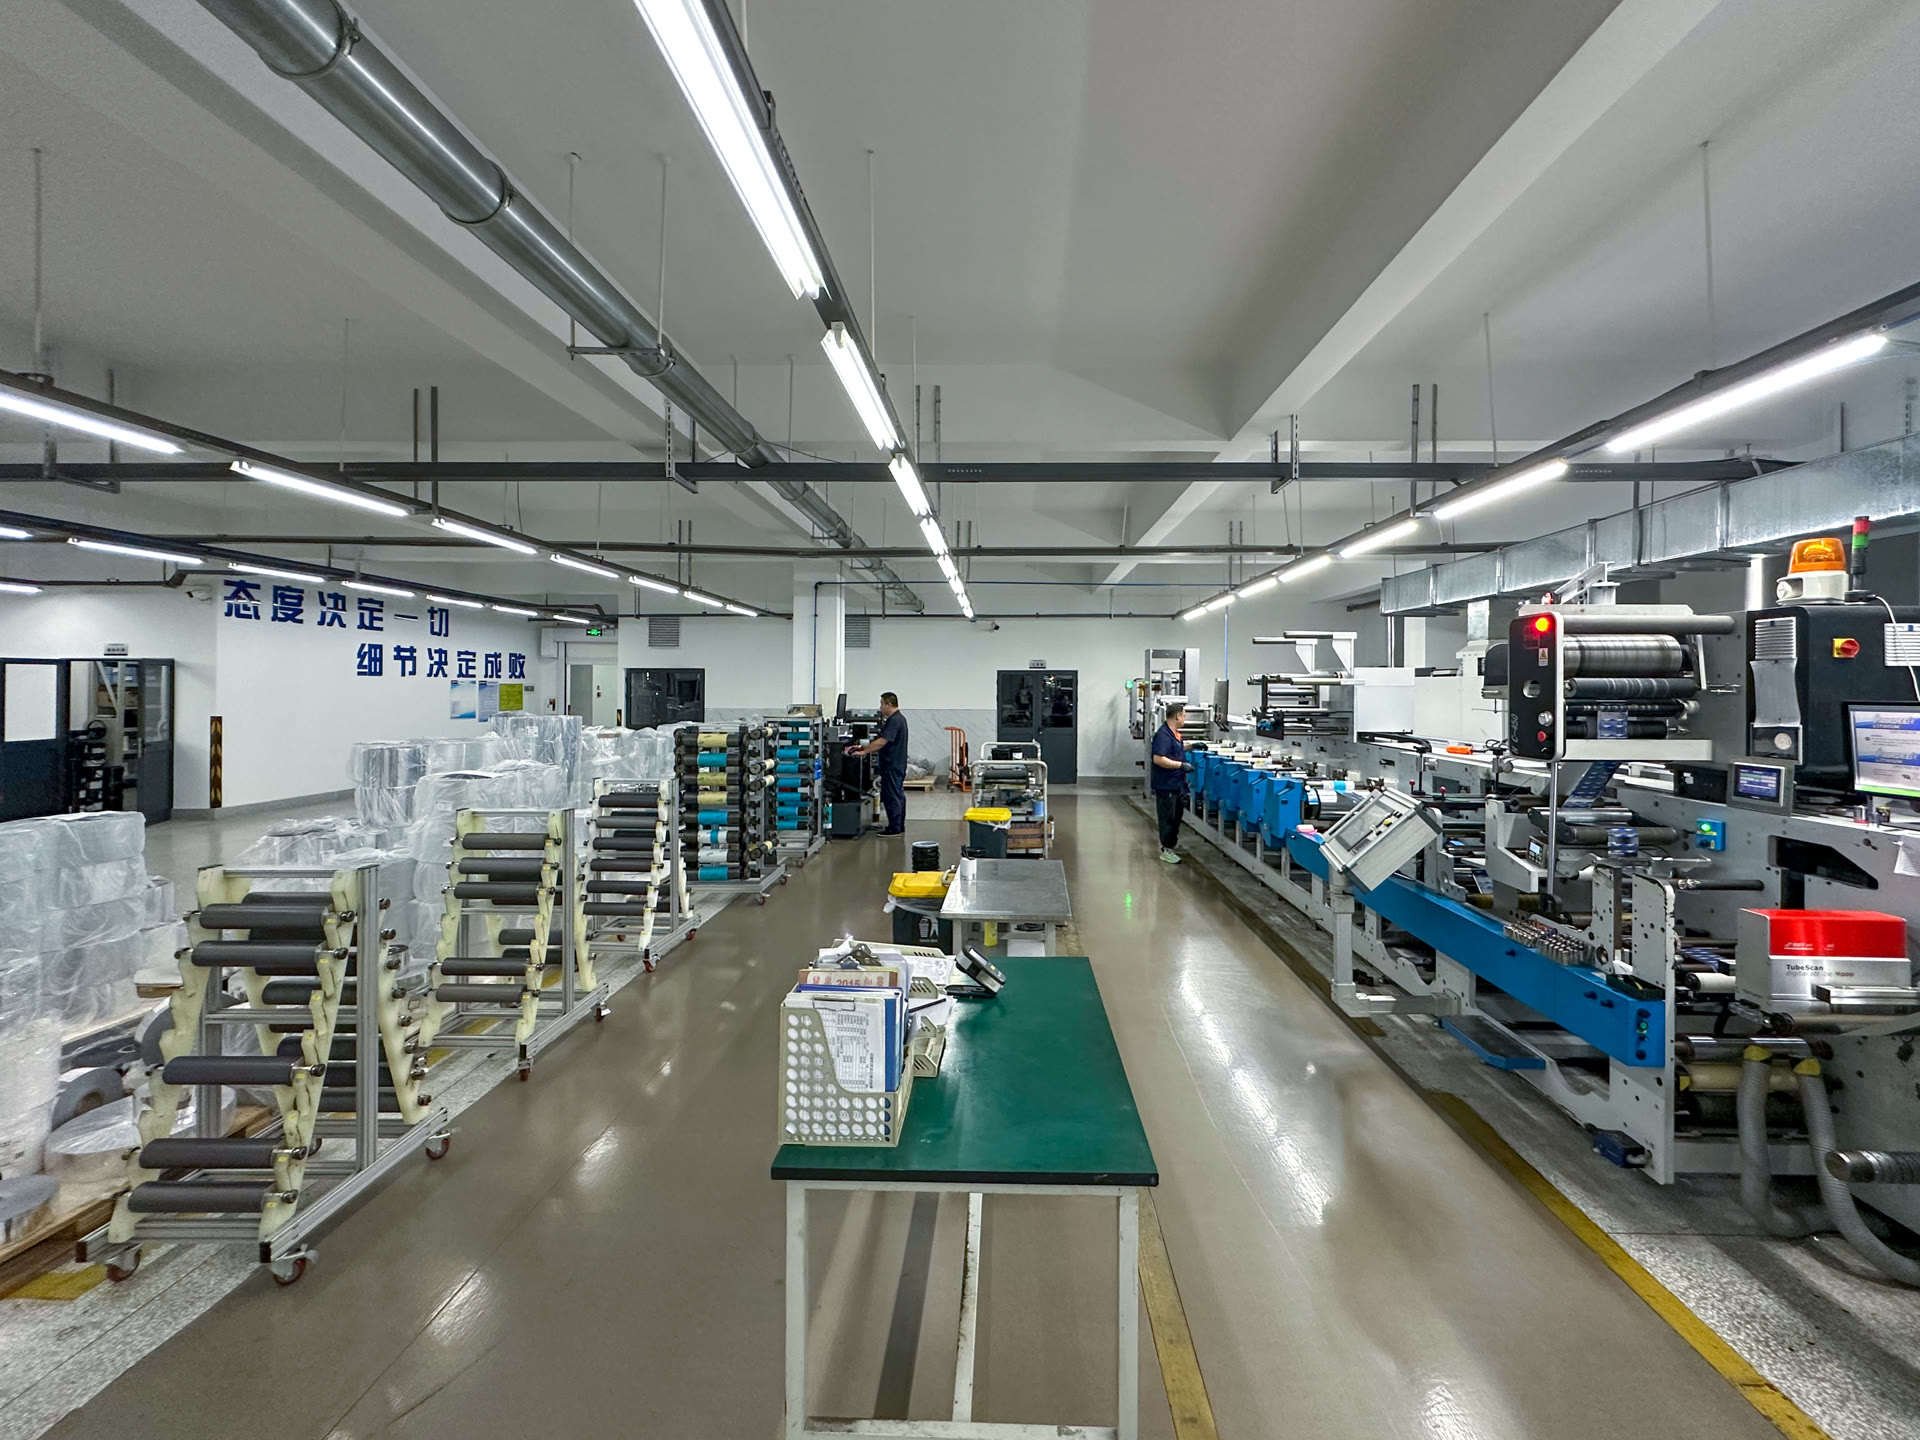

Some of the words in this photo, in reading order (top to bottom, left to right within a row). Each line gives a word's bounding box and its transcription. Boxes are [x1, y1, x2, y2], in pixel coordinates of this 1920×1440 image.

[224, 579, 449, 637] 态度决定一切
[357, 643, 526, 679] 细节决定成败
